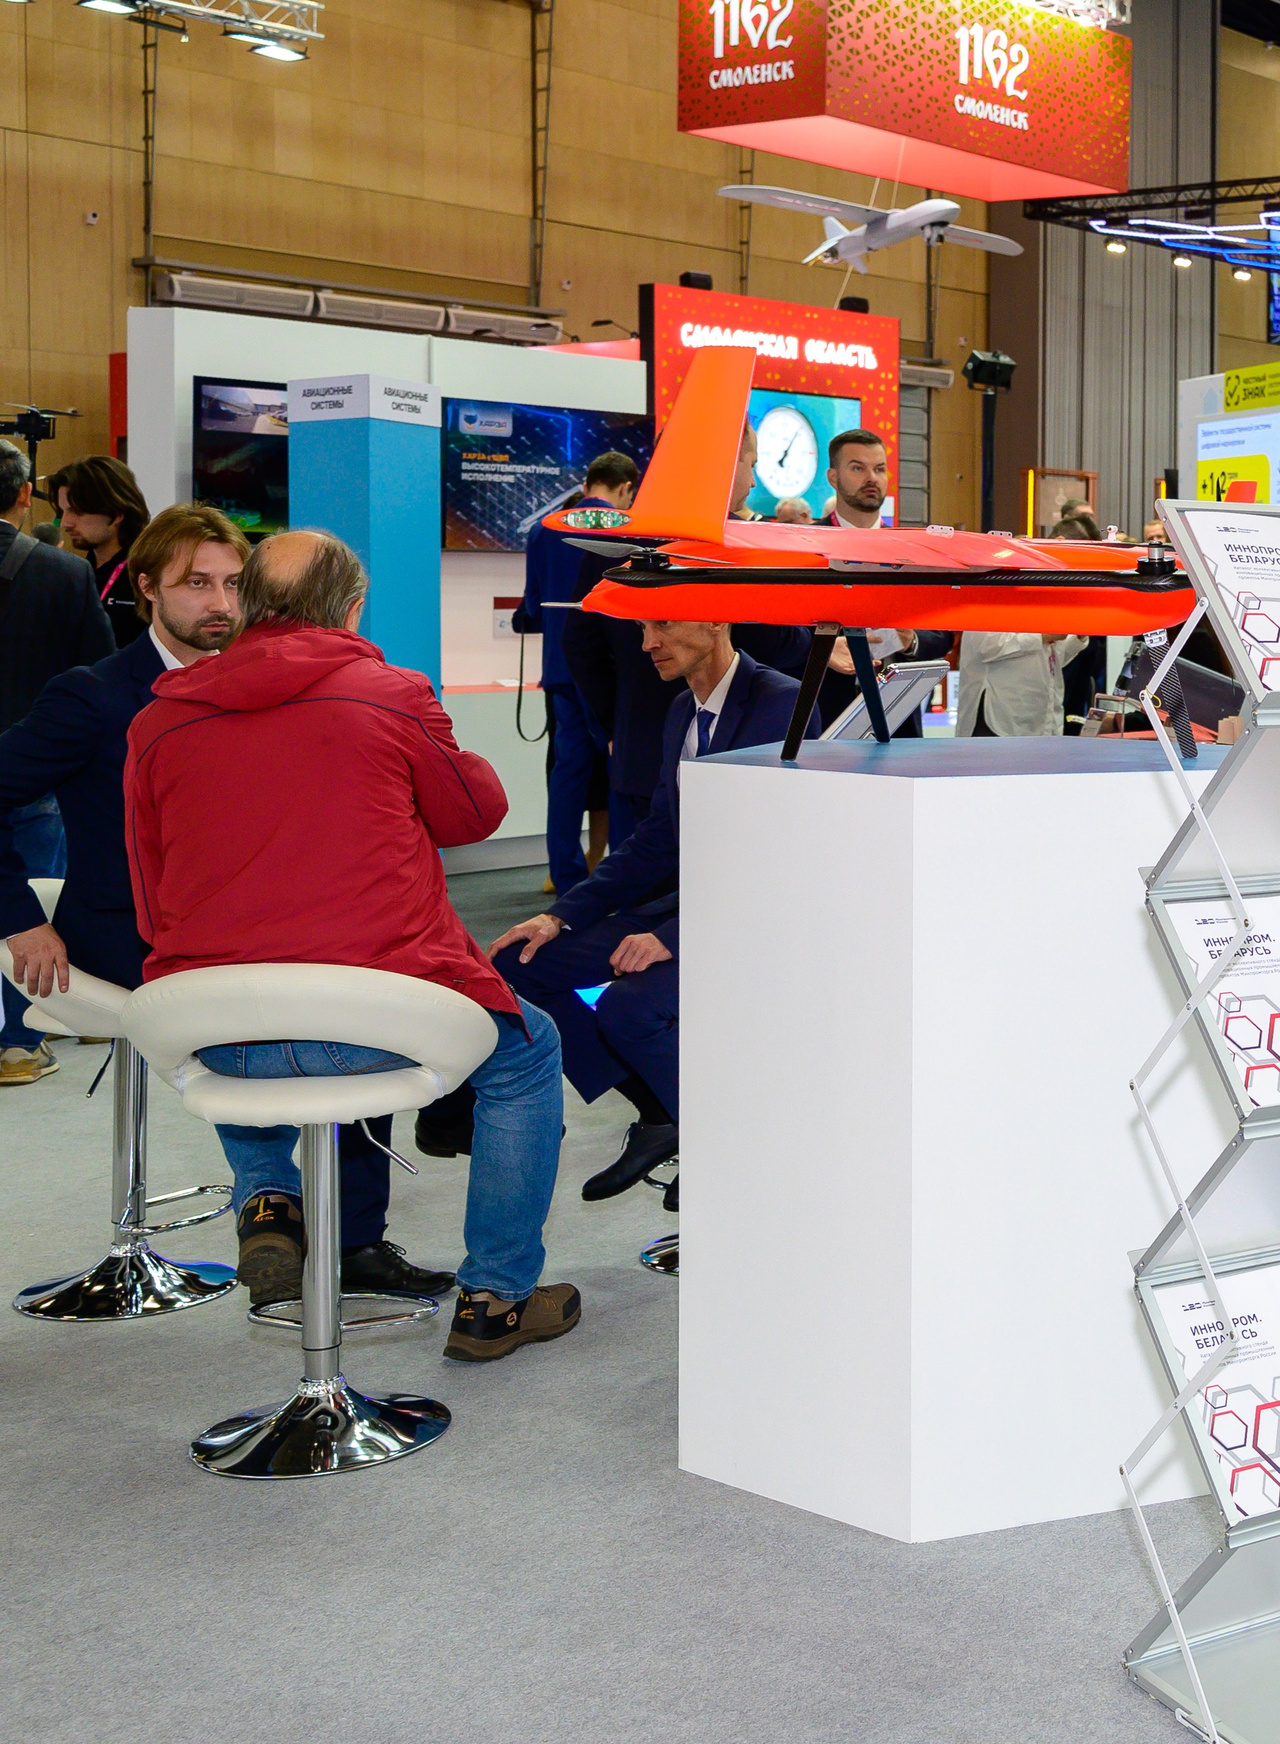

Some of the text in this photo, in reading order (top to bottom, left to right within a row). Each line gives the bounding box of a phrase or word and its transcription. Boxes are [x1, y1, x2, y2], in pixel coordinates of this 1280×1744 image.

[708, 0, 794, 58] 1162
[954, 22, 1029, 100] 1162
[708, 59, 795, 91] СМОЛЕНСК
[954, 93, 1029, 131] СМОЛЕНСК
[804, 338, 878, 370] ОБЛАСТЬ
[302, 385, 353, 398] АВИАЦИОННЫЕ
[383, 386, 428, 402] АВИАЦИОННЫЕ
[310, 400, 344, 411] СИСТЕМЫ
[391, 401, 421, 414] СИСТЕМЫ
[1208, 946, 1272, 960] БЕАРУСЬ
[1190, 1313, 1262, 1336] ИННОРОМ.
[1195, 1328, 1258, 1350] БЕЛАСЬ
